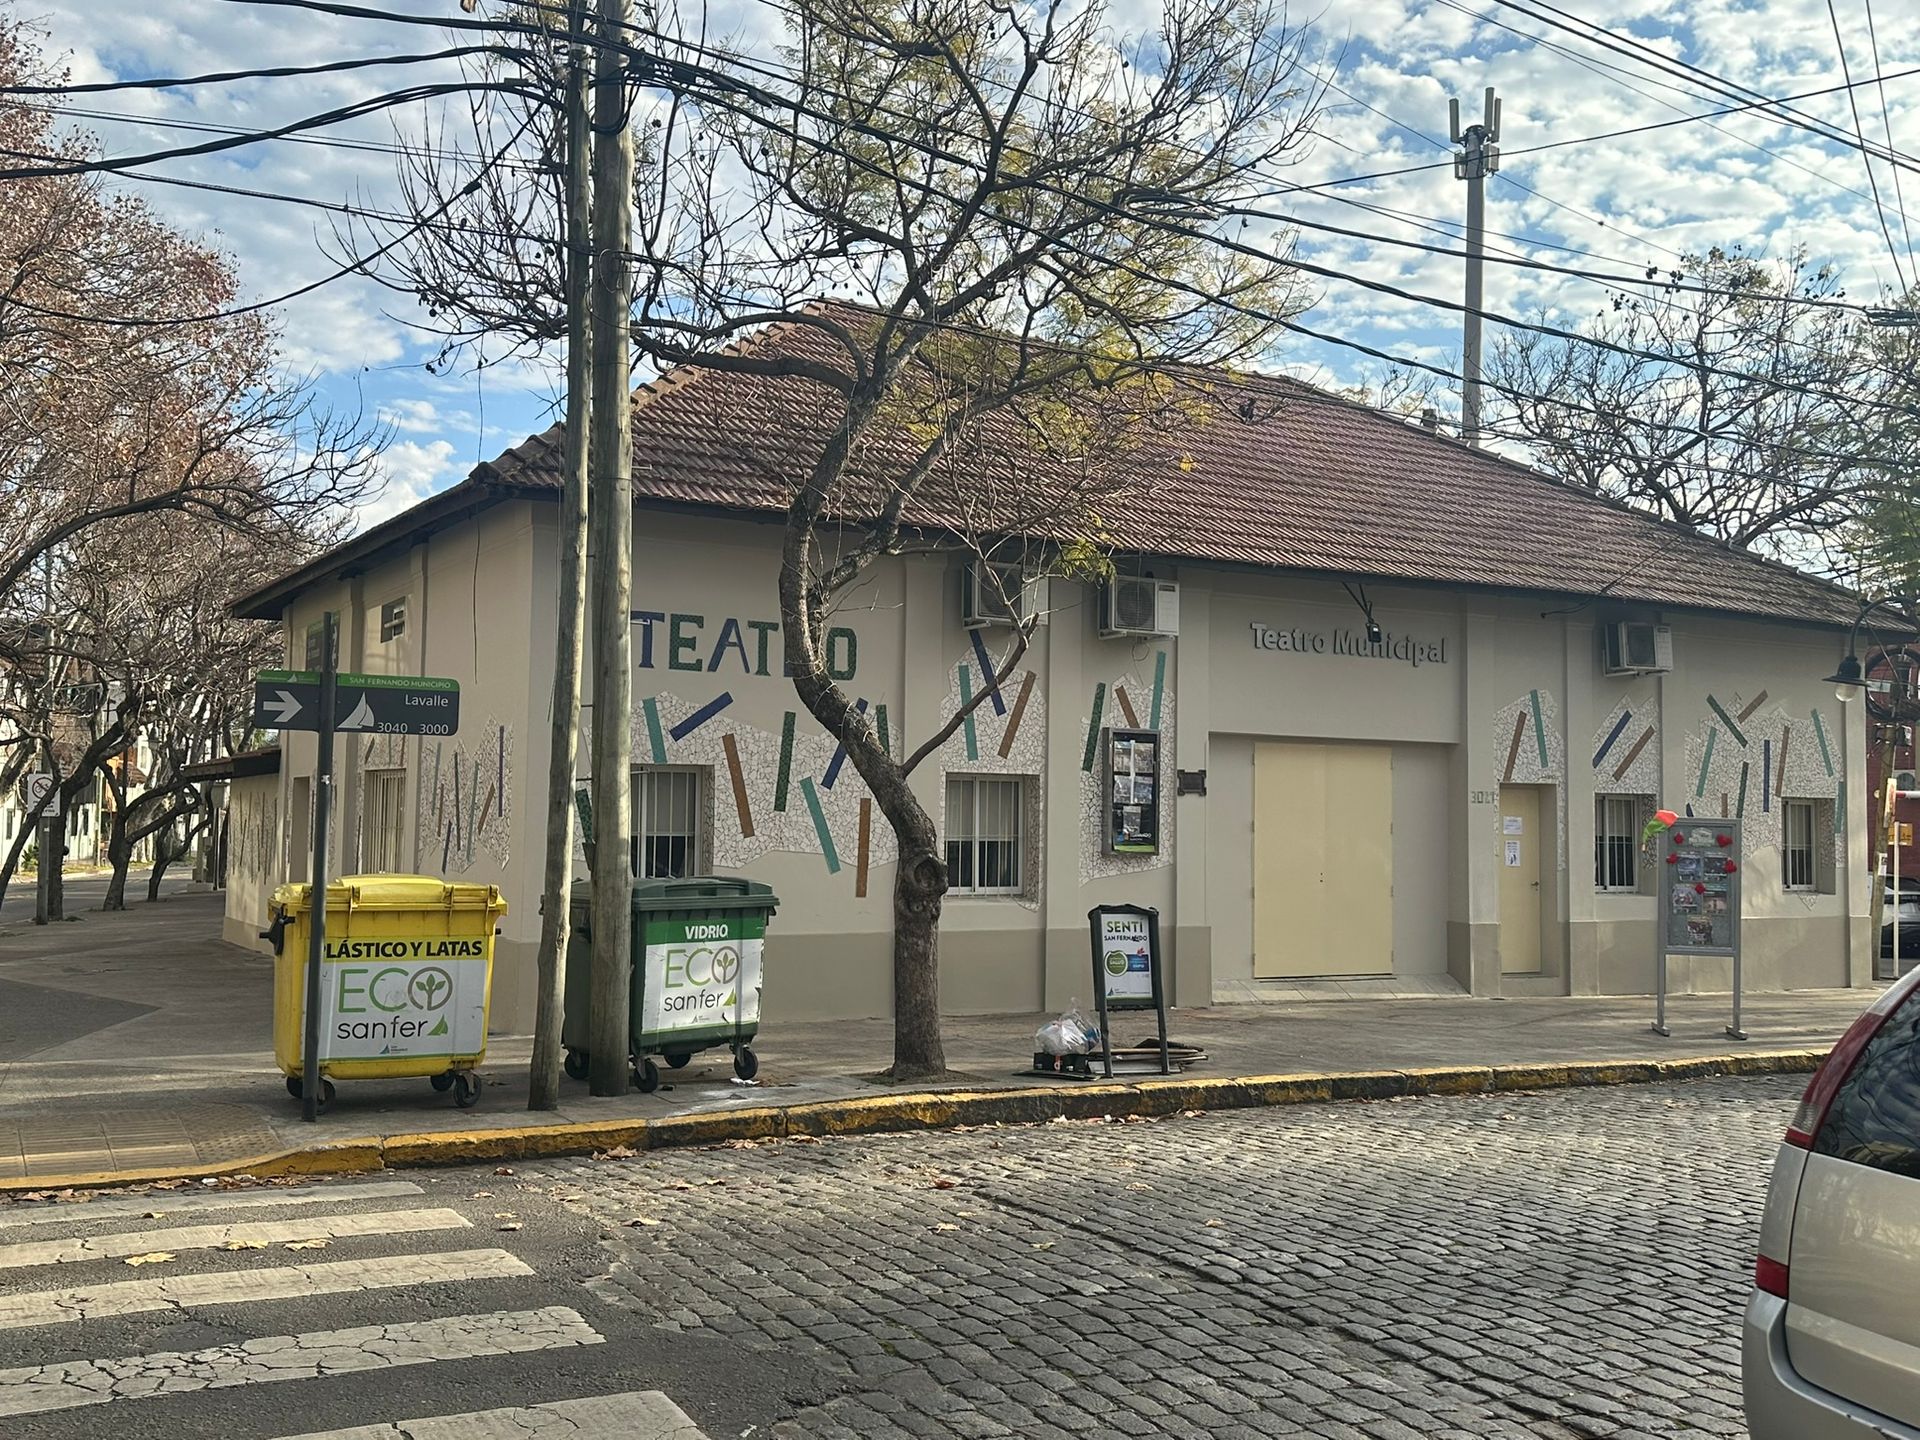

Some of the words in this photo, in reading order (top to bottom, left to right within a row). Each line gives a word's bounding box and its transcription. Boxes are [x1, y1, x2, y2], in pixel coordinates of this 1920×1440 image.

[631, 610, 857, 680] TEATO
[1250, 622, 1324, 654] Teatro
[1333, 628, 1447, 667] Municipal
[349, 677, 365, 685] SAN
[367, 678, 410, 687] FERNANDO
[411, 681, 451, 689] MUNICIPIO
[405, 694, 449, 707] Lavalle
[377, 722, 408, 733] 3040
[419, 723, 449, 734] 3000
[685, 924, 728, 940] VIDRIO
[323, 940, 408, 959] LÁSTICO
[410, 941, 423, 957] Y
[426, 940, 483, 956] LATAS
[665, 946, 740, 988] ECO
[338, 966, 453, 1013] ECO
[663, 989, 724, 1012] sanfer
[337, 1015, 428, 1040] sanfer
